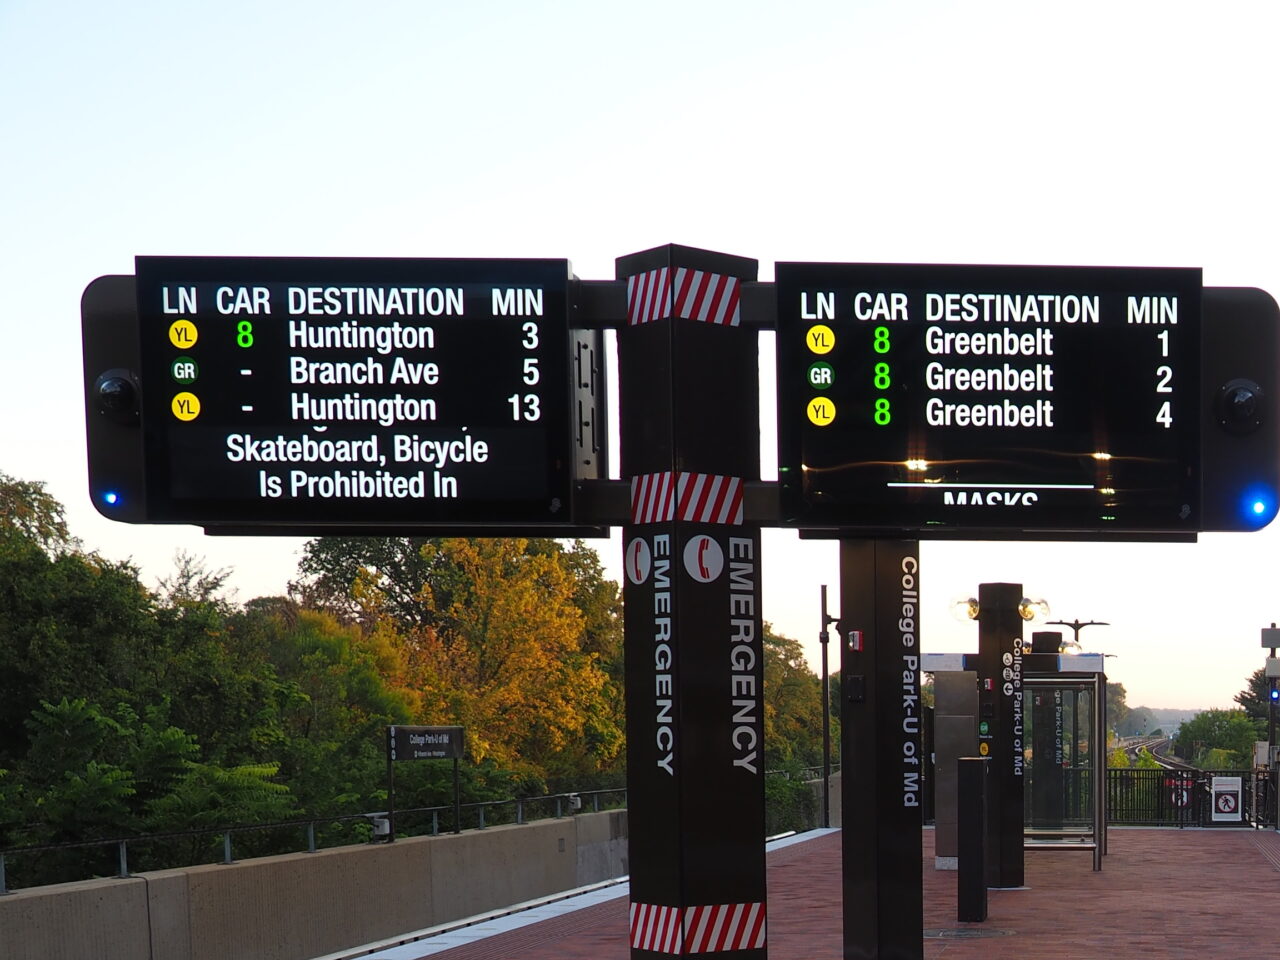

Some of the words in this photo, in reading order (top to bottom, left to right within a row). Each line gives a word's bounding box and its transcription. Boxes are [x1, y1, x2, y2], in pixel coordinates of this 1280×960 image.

[162, 286, 197, 314] LN
[216, 286, 271, 315] CAR
[288, 287, 464, 316] DESTINATION
[491, 288, 544, 316] MIN
[800, 291, 835, 320] LN
[854, 292, 908, 321] CAR
[925, 293, 1100, 323] DESTINATION
[1127, 296, 1178, 325] MIN
[174, 327, 193, 342] YL
[236, 320, 253, 348] 8
[288, 320, 435, 354] Huntington
[522, 321, 539, 350] 3
[812, 332, 830, 347] YL
[873, 326, 891, 354] 8
[925, 325, 1054, 356] Greenbelt
[1156, 329, 1169, 357] 1
[173, 362, 195, 378] GR
[290, 357, 384, 385] Branch
[389, 357, 439, 385] Ave
[522, 358, 540, 386] 5
[810, 367, 831, 384] GR
[873, 362, 891, 390] 8
[925, 361, 1054, 392] Greenbelt
[1156, 365, 1173, 393] 2
[177, 399, 195, 414] YL
[291, 393, 437, 426] Huntington
[507, 393, 541, 422] 13
[813, 404, 830, 419] YL
[874, 397, 891, 426] 8
[925, 397, 1054, 428] Greenbelt
[1155, 401, 1173, 429] 4
[226, 433, 386, 467] Skateboard,
[393, 434, 489, 469] Bicycle
[259, 470, 283, 498] Is
[290, 470, 425, 499] Prohibited
[433, 470, 458, 498] In
[899, 556, 918, 648] College
[653, 533, 674, 777] EMERGENCY
[728, 536, 757, 775] EMERGENCY
[1012, 638, 1023, 688] College
[903, 655, 919, 734] Park-U
[1014, 692, 1023, 735] Park-U
[903, 741, 919, 765] of
[1014, 739, 1023, 752] of
[1014, 756, 1023, 776] Md
[903, 772, 919, 807] Md
